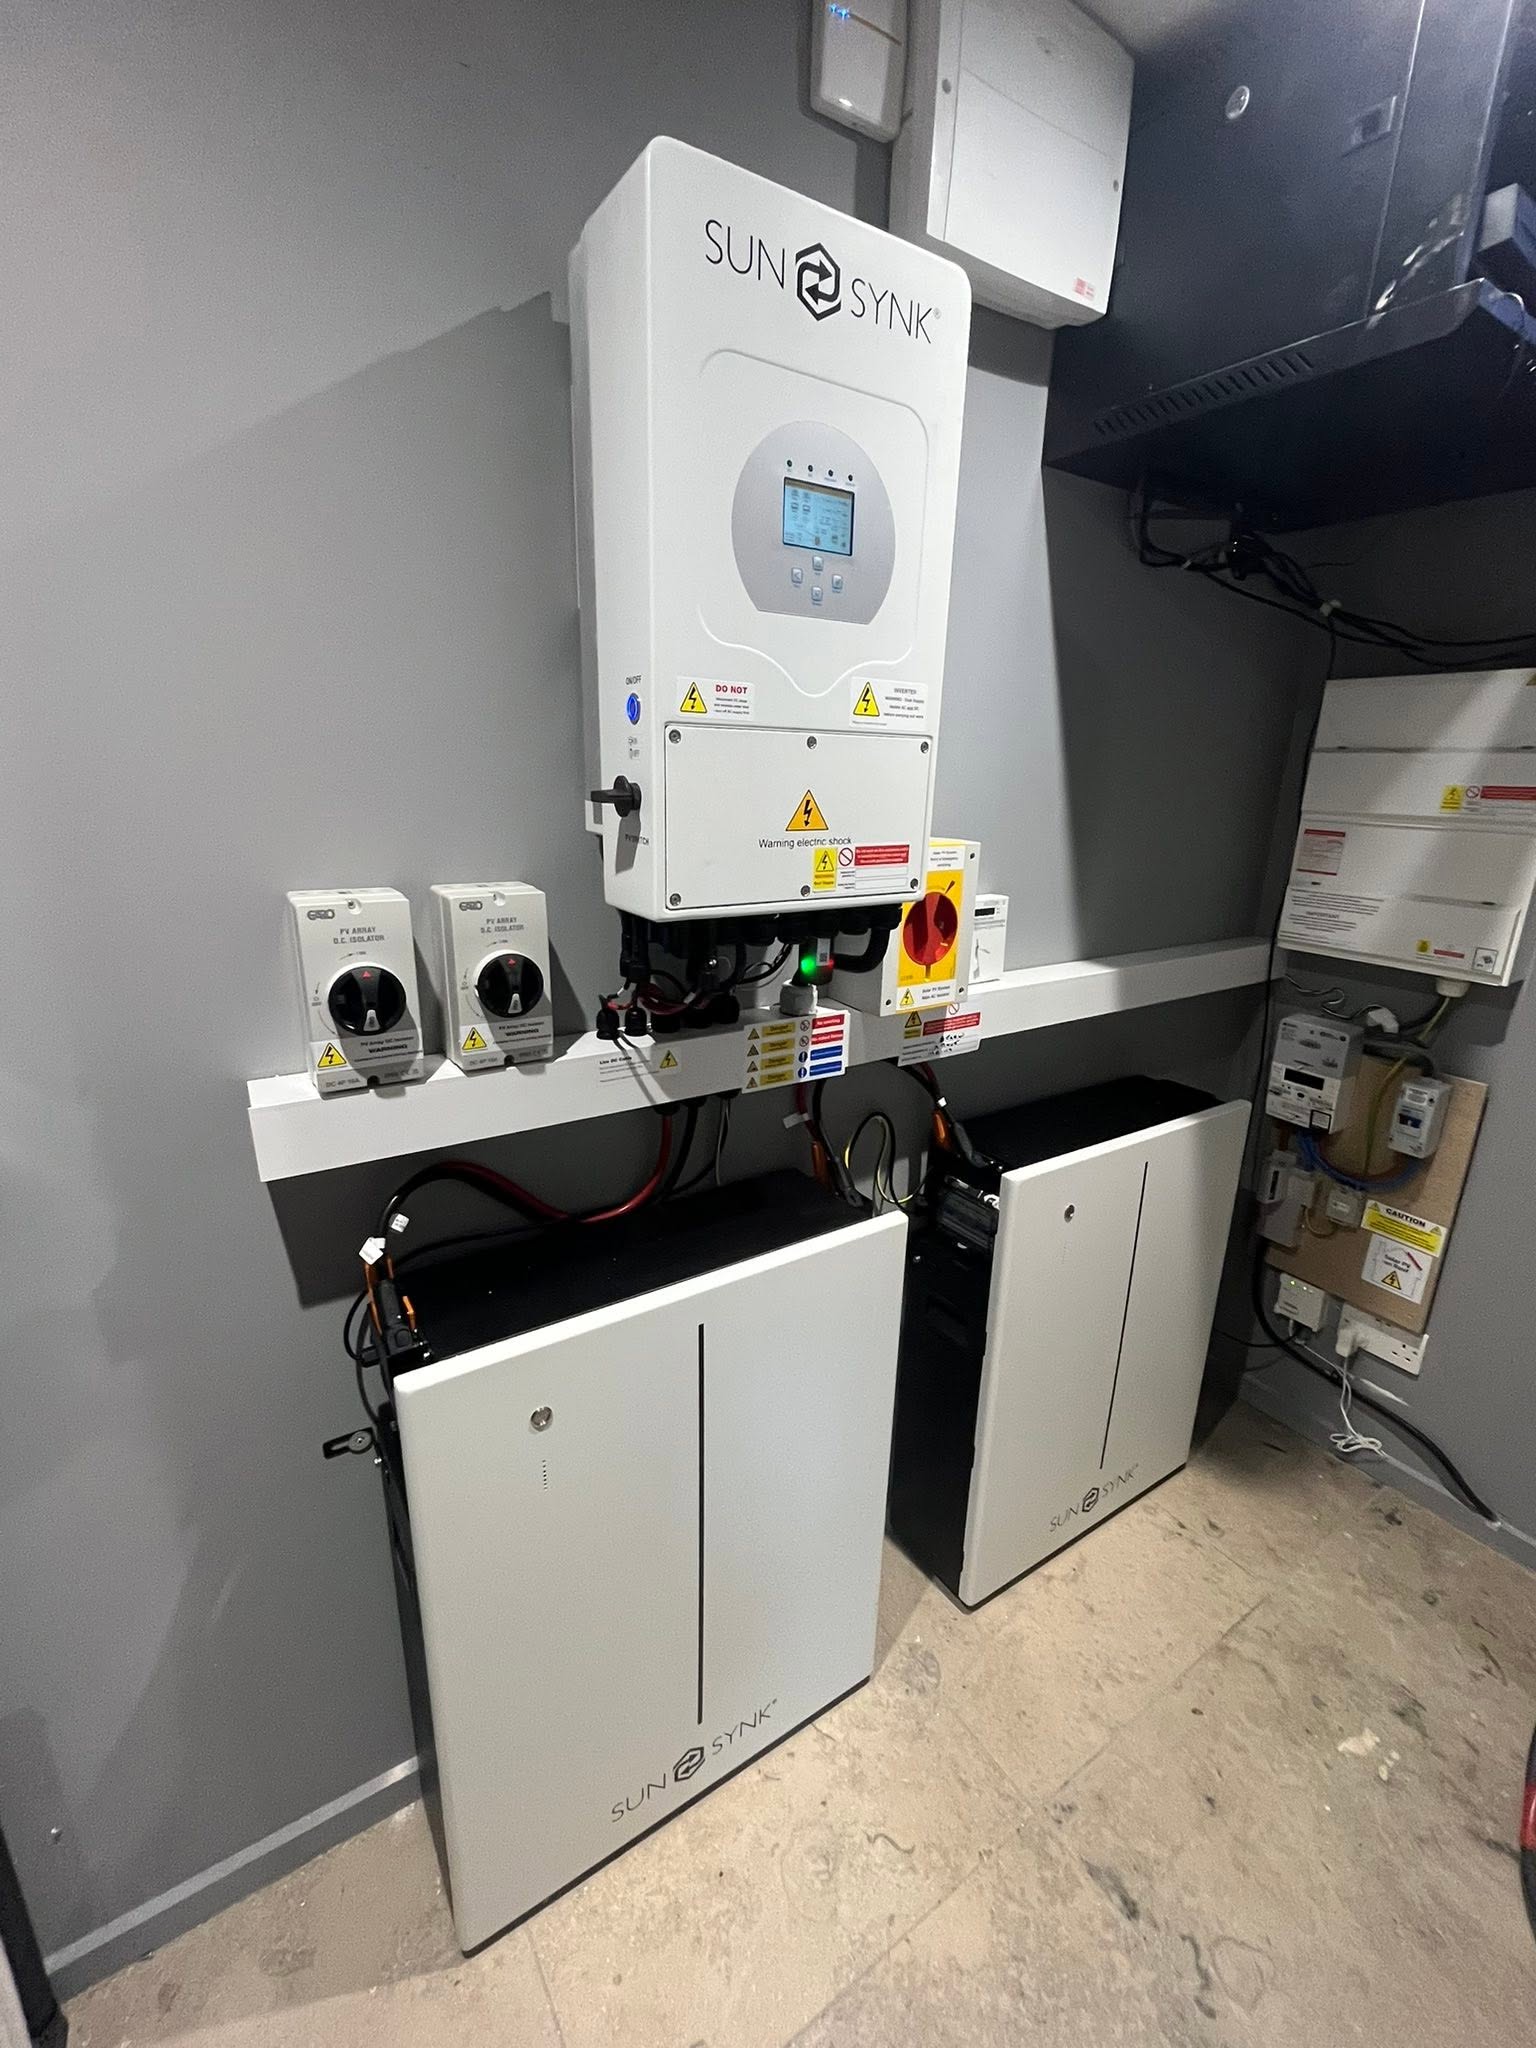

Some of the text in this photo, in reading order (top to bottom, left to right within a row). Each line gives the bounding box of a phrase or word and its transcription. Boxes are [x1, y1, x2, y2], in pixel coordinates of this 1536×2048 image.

[705, 219, 785, 289] SUN
[715, 684, 748, 694] DO NOT
[758, 836, 852, 849] Warning electric shock
[352, 926, 376, 935] ARRAY
[1386, 1208, 1426, 1228] CAUTION
[1049, 1503, 1080, 1533] SUN
[611, 1773, 666, 1823] SUN
